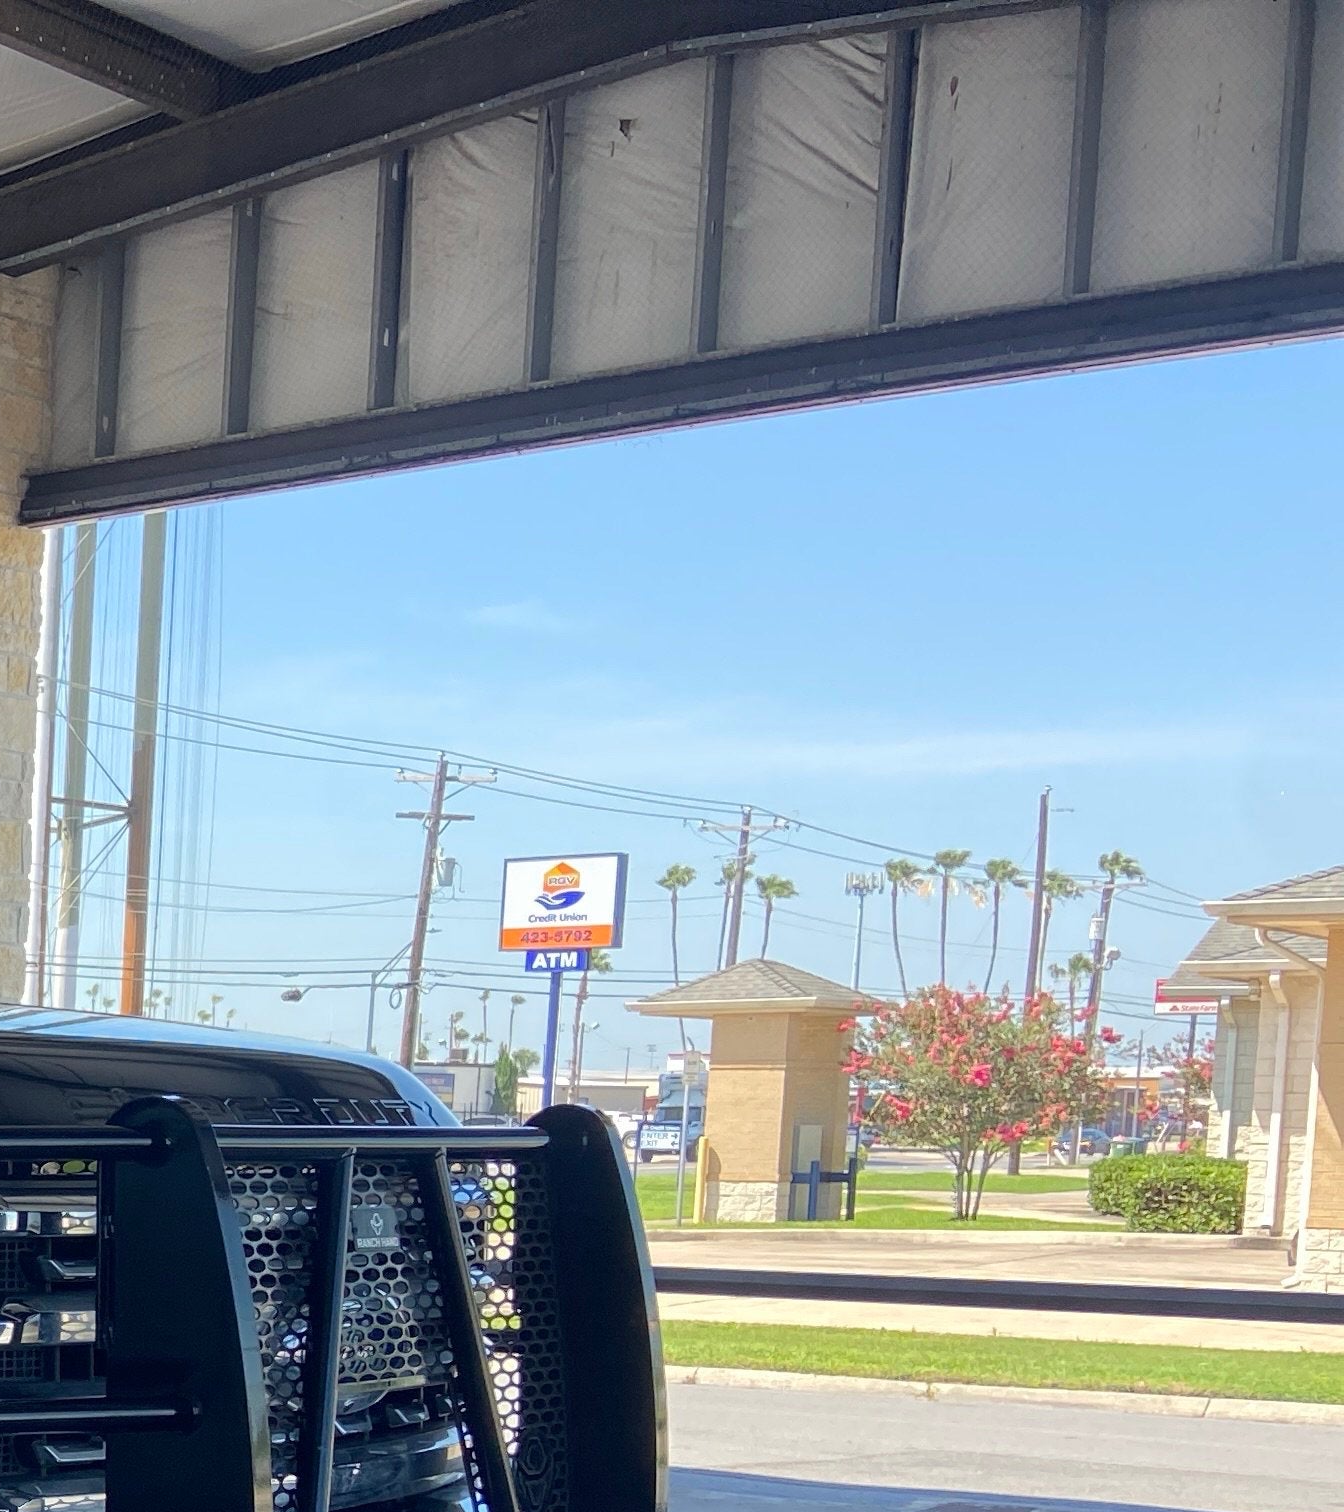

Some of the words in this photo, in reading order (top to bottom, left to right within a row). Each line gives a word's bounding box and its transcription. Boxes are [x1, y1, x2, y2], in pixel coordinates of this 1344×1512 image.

[528, 913, 557, 923] Credit
[560, 912, 588, 922] Union
[531, 951, 578, 969] ATM
